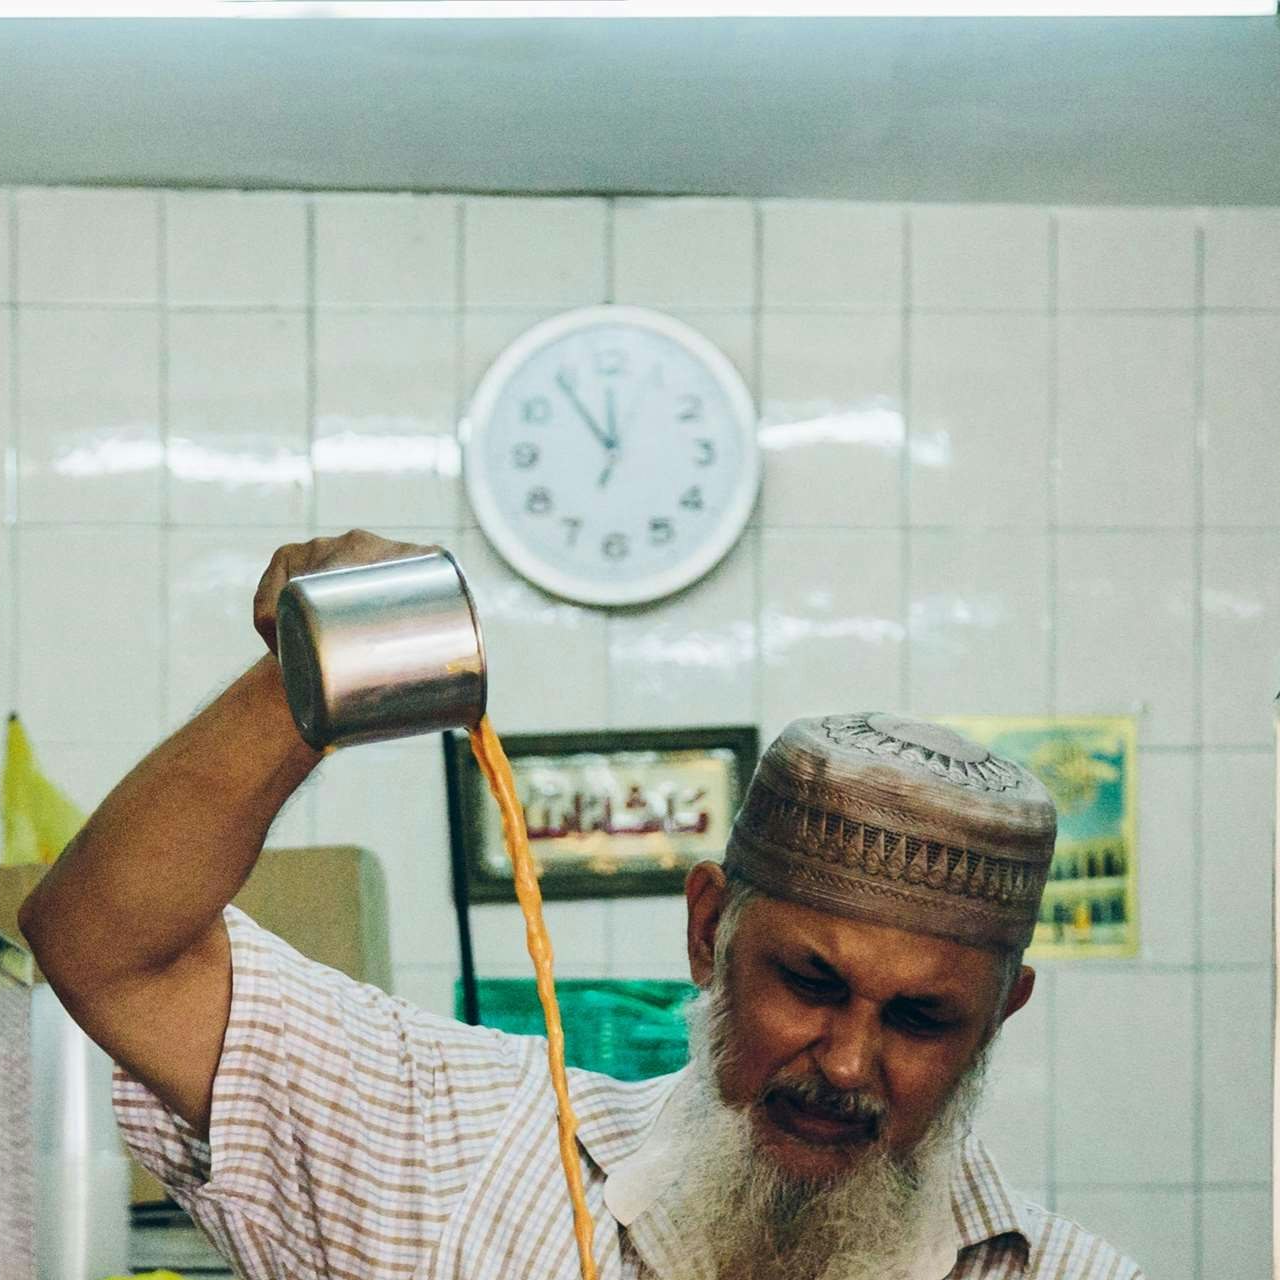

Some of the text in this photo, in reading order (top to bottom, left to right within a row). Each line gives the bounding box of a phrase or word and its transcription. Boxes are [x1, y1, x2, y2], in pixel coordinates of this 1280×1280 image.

[677, 395, 702, 423] 2
[511, 441, 541, 470] 9
[694, 437, 716, 468] 3
[525, 485, 553, 515] 8
[678, 484, 706, 512] 4
[560, 516, 585, 547] 7
[648, 516, 676, 546] 5
[601, 532, 631, 562] 6
